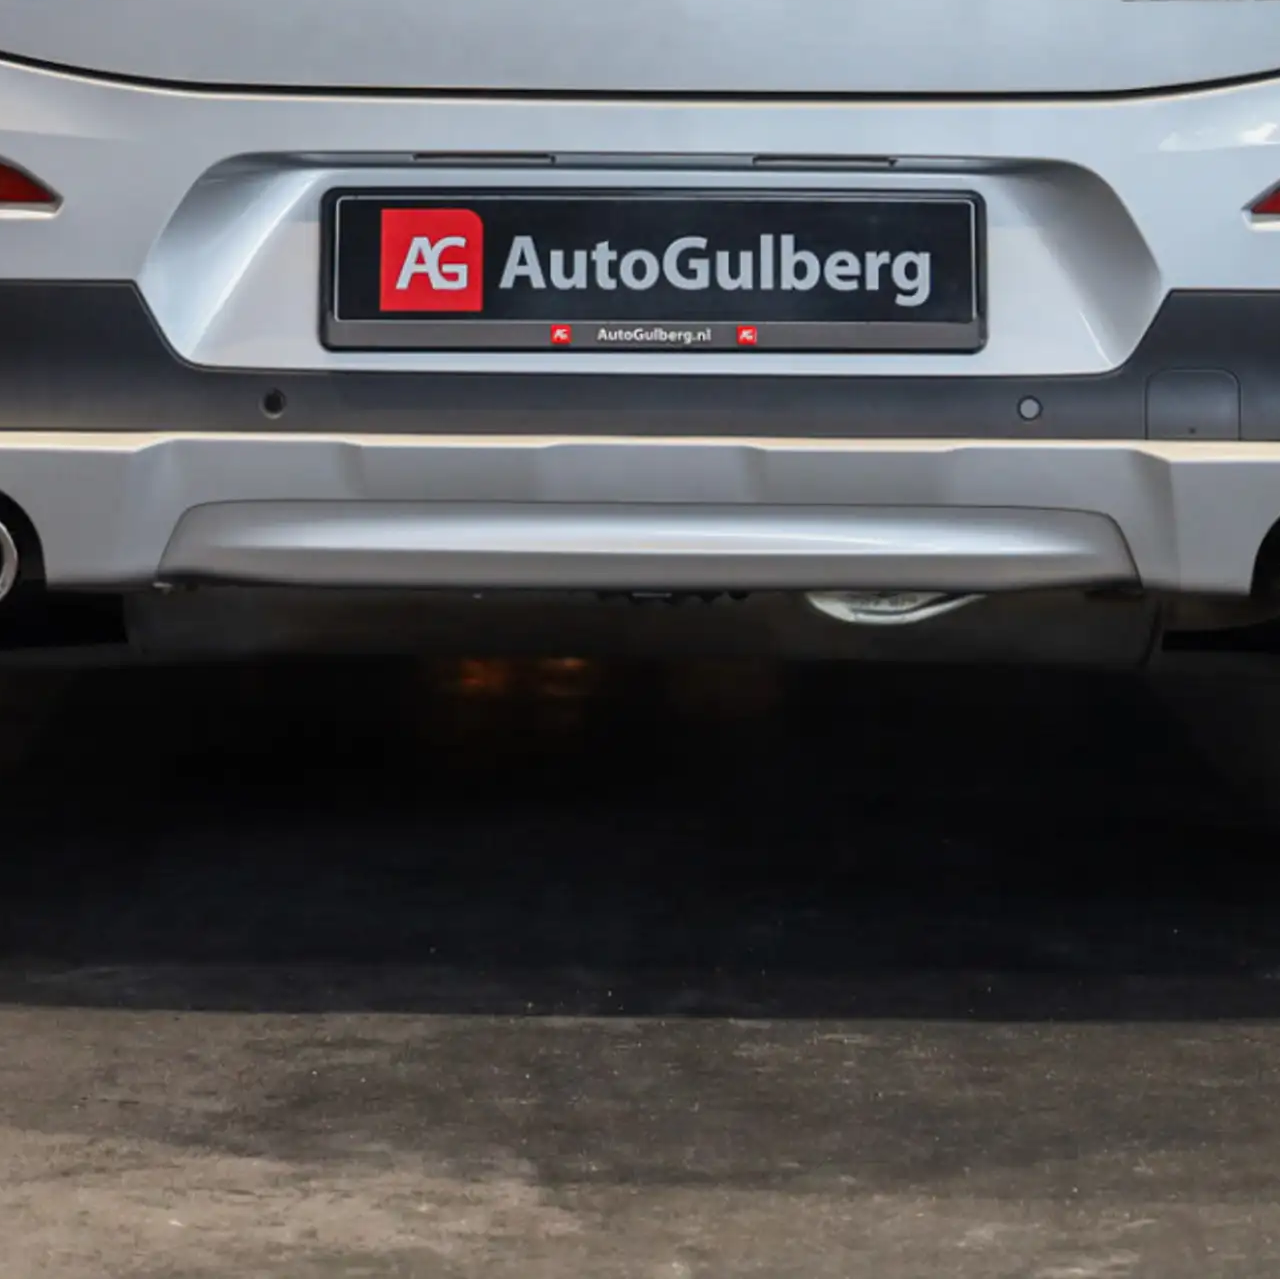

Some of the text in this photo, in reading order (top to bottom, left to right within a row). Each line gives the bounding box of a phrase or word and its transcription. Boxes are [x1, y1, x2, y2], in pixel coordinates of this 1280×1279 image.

[395, 234, 931, 308] AG AutoGulberg
[597, 328, 711, 344] AutoGulberg.nl
